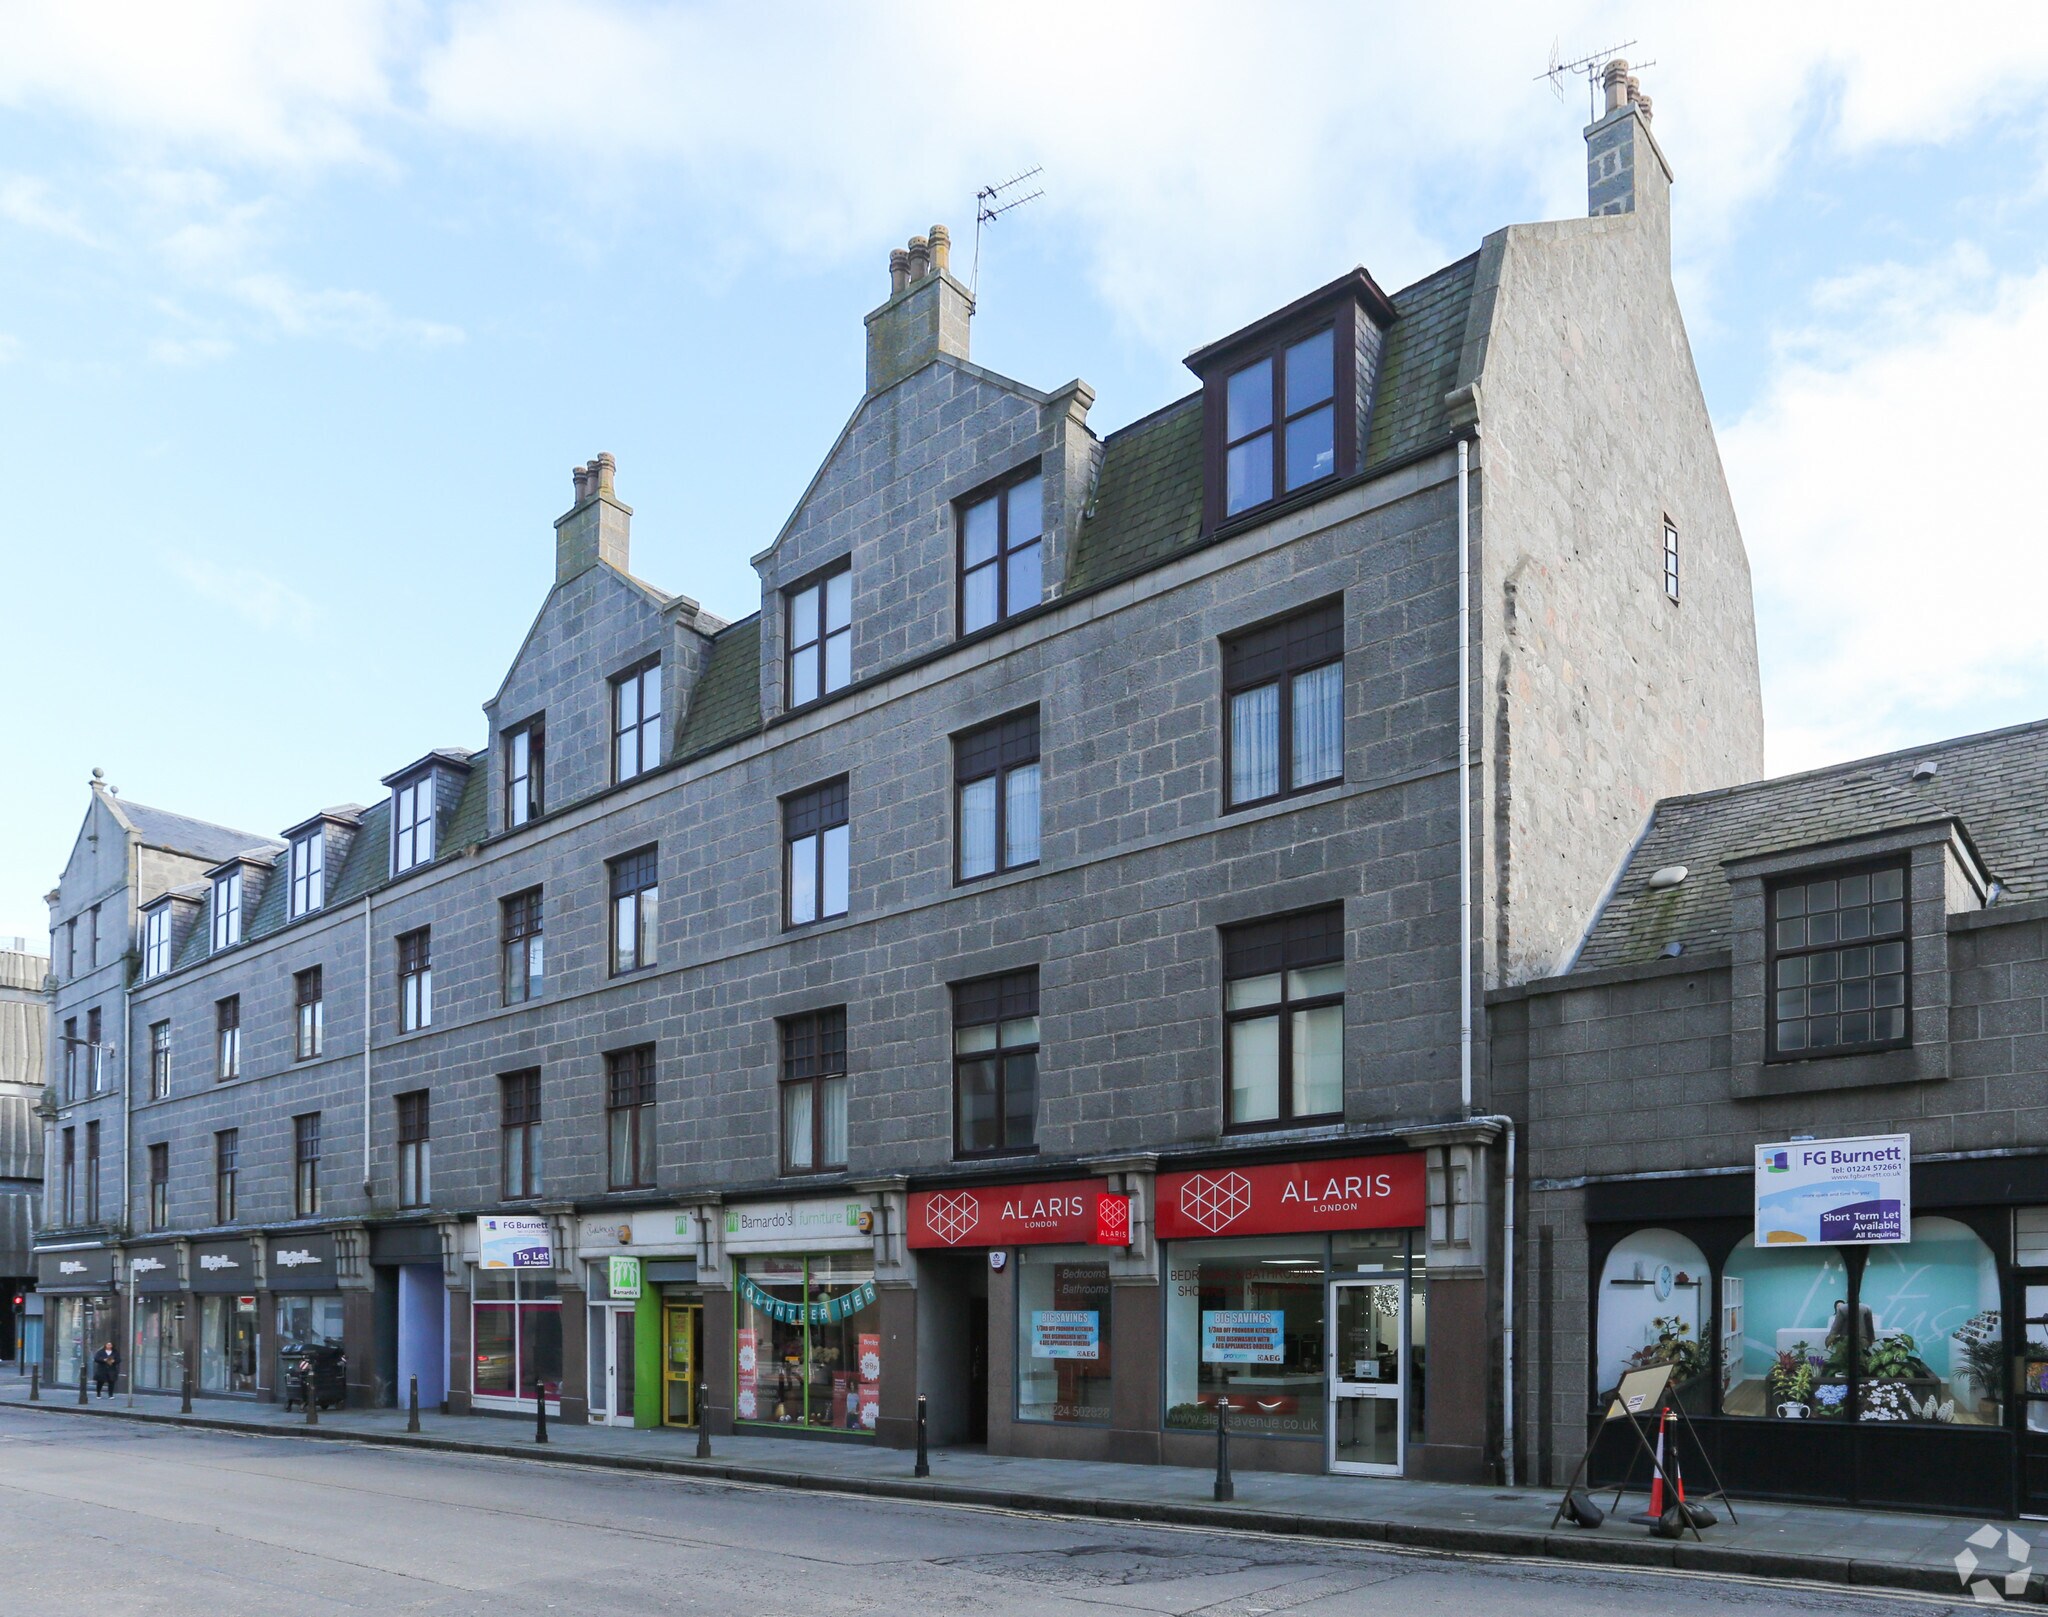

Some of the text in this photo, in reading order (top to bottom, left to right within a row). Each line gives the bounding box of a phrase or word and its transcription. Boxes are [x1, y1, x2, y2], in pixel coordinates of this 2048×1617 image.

[1803, 1147, 1901, 1166] FG Burnett
[1832, 1163, 1902, 1174] Tel: 01224 572661
[1281, 1174, 1391, 1203] ALARIS
[1001, 1196, 1083, 1220] ALARIS
[1313, 1203, 1358, 1213] LONDON
[741, 1212, 793, 1229] Barnardo's
[799, 1211, 842, 1225] furniture
[1823, 1211, 1899, 1222] Short Term Let
[503, 1221, 549, 1229] FG Burnett
[1024, 1221, 1058, 1229] LONDON
[1853, 1222, 1900, 1231] Available
[1100, 1230, 1127, 1238] ALARIS
[1856, 1230, 1900, 1239] All Enquiries
[516, 1252, 549, 1261] To Let
[1062, 1268, 1107, 1279] Bedrooms
[1062, 1284, 1109, 1294] Bathrooms
[1042, 1312, 1088, 1323] BIG SAVINGS
[1215, 1312, 1272, 1324] BIG SAVINGS
[1264, 1354, 1280, 1362] AEG
[1171, 1412, 1318, 1431] www.alasavenue.co.uk
